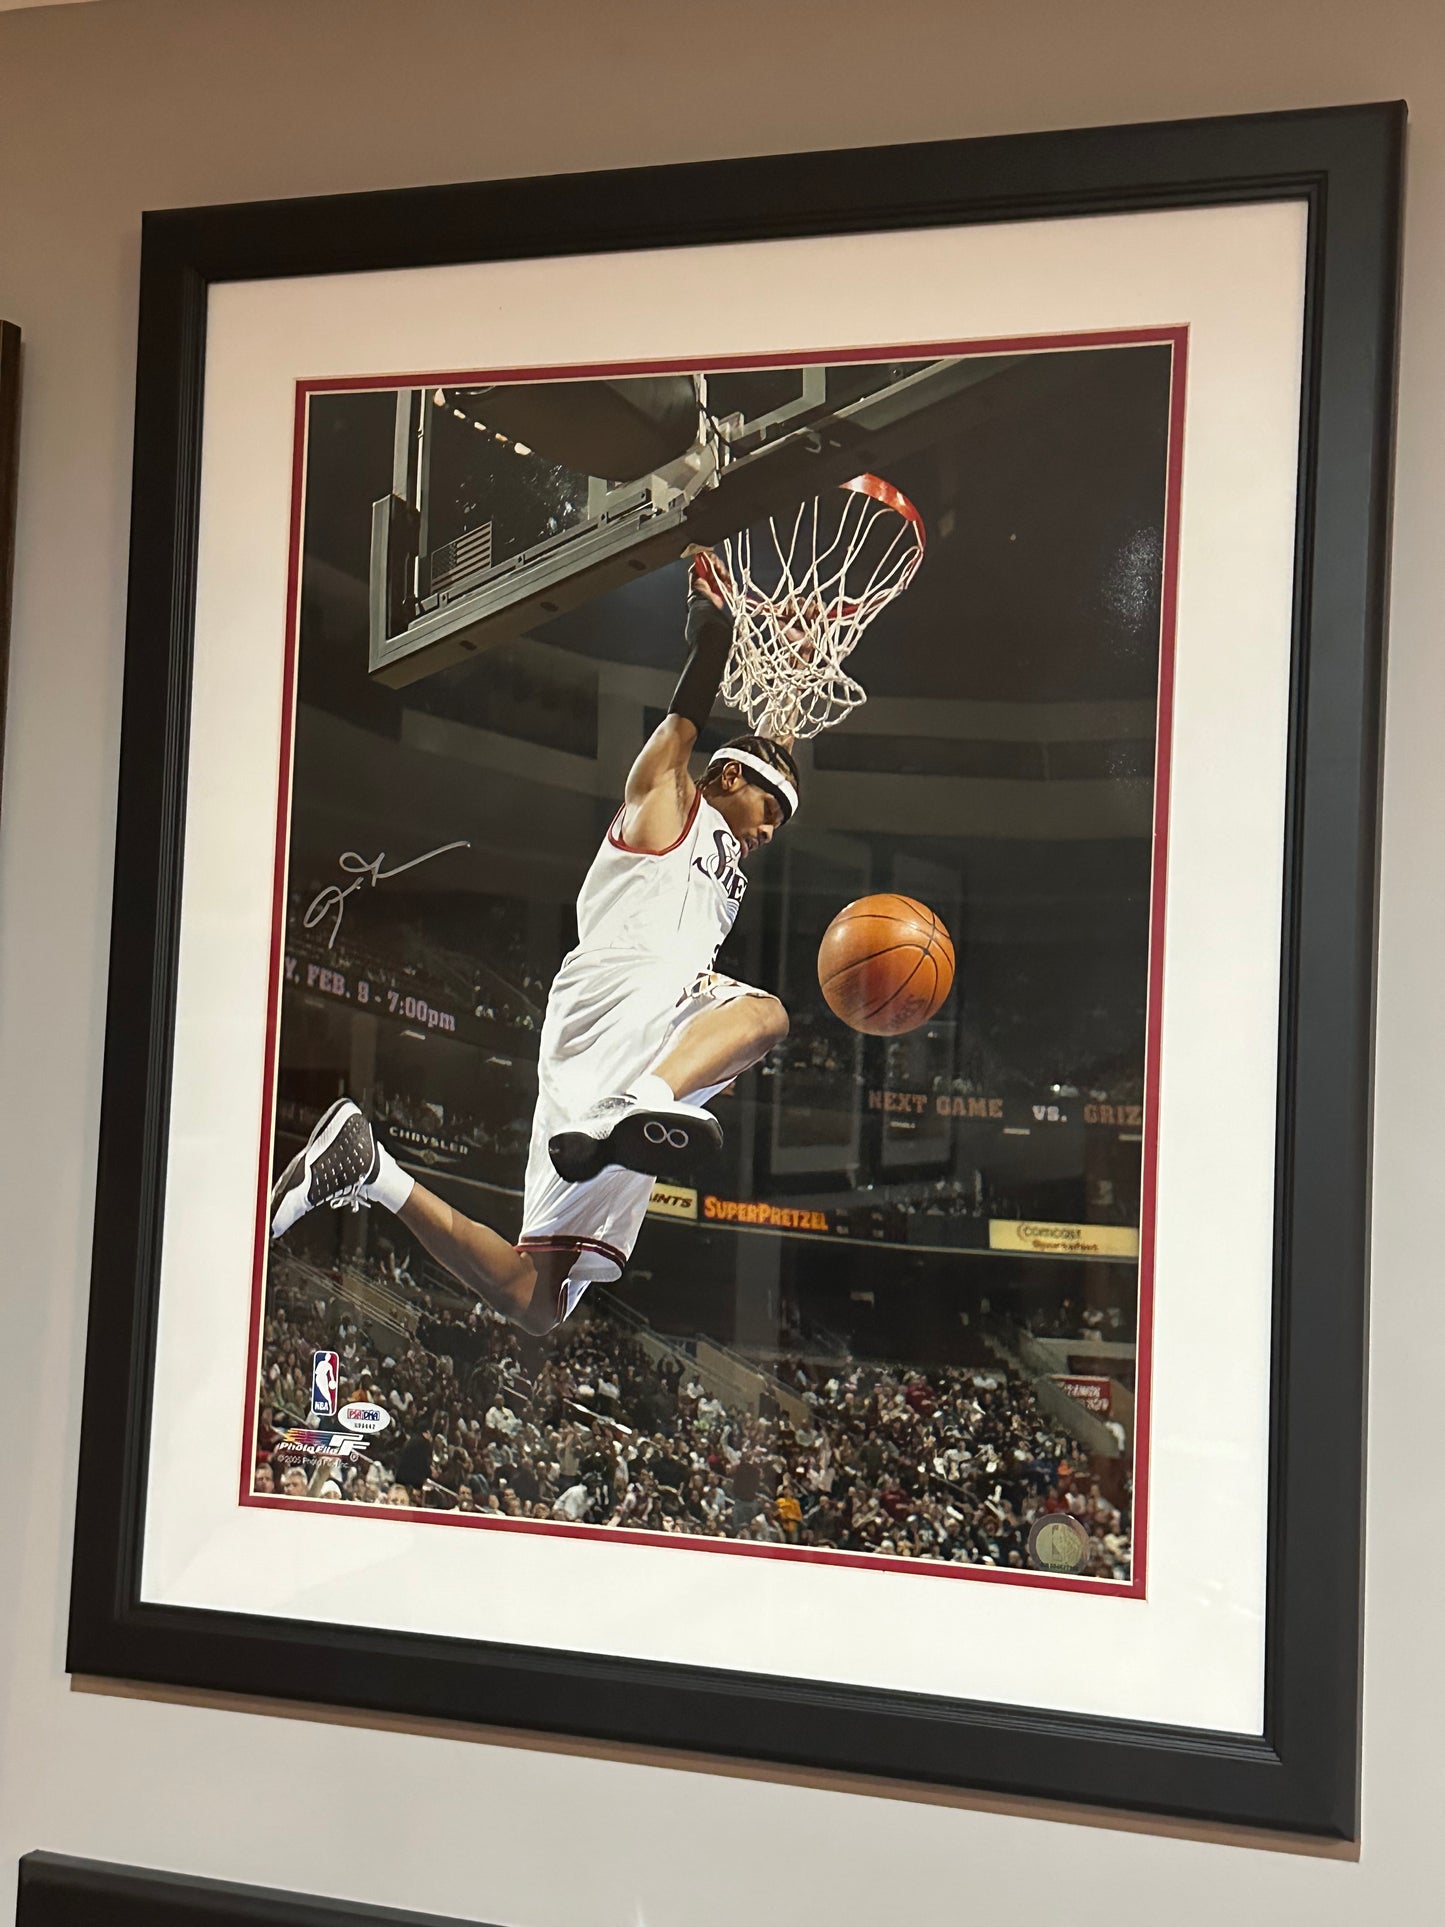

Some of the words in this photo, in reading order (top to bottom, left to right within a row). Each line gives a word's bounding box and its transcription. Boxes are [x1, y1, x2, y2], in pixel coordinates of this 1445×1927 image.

[308, 963, 350, 998] FEB.
[387, 990, 455, 1031] 7:00pm
[868, 1089, 927, 1113] NEXT
[935, 1095, 1003, 1118] GAME
[389, 1126, 469, 1155] CHRYSLER
[650, 1193, 692, 1208] INTS
[314, 1401, 329, 1411] NBA
